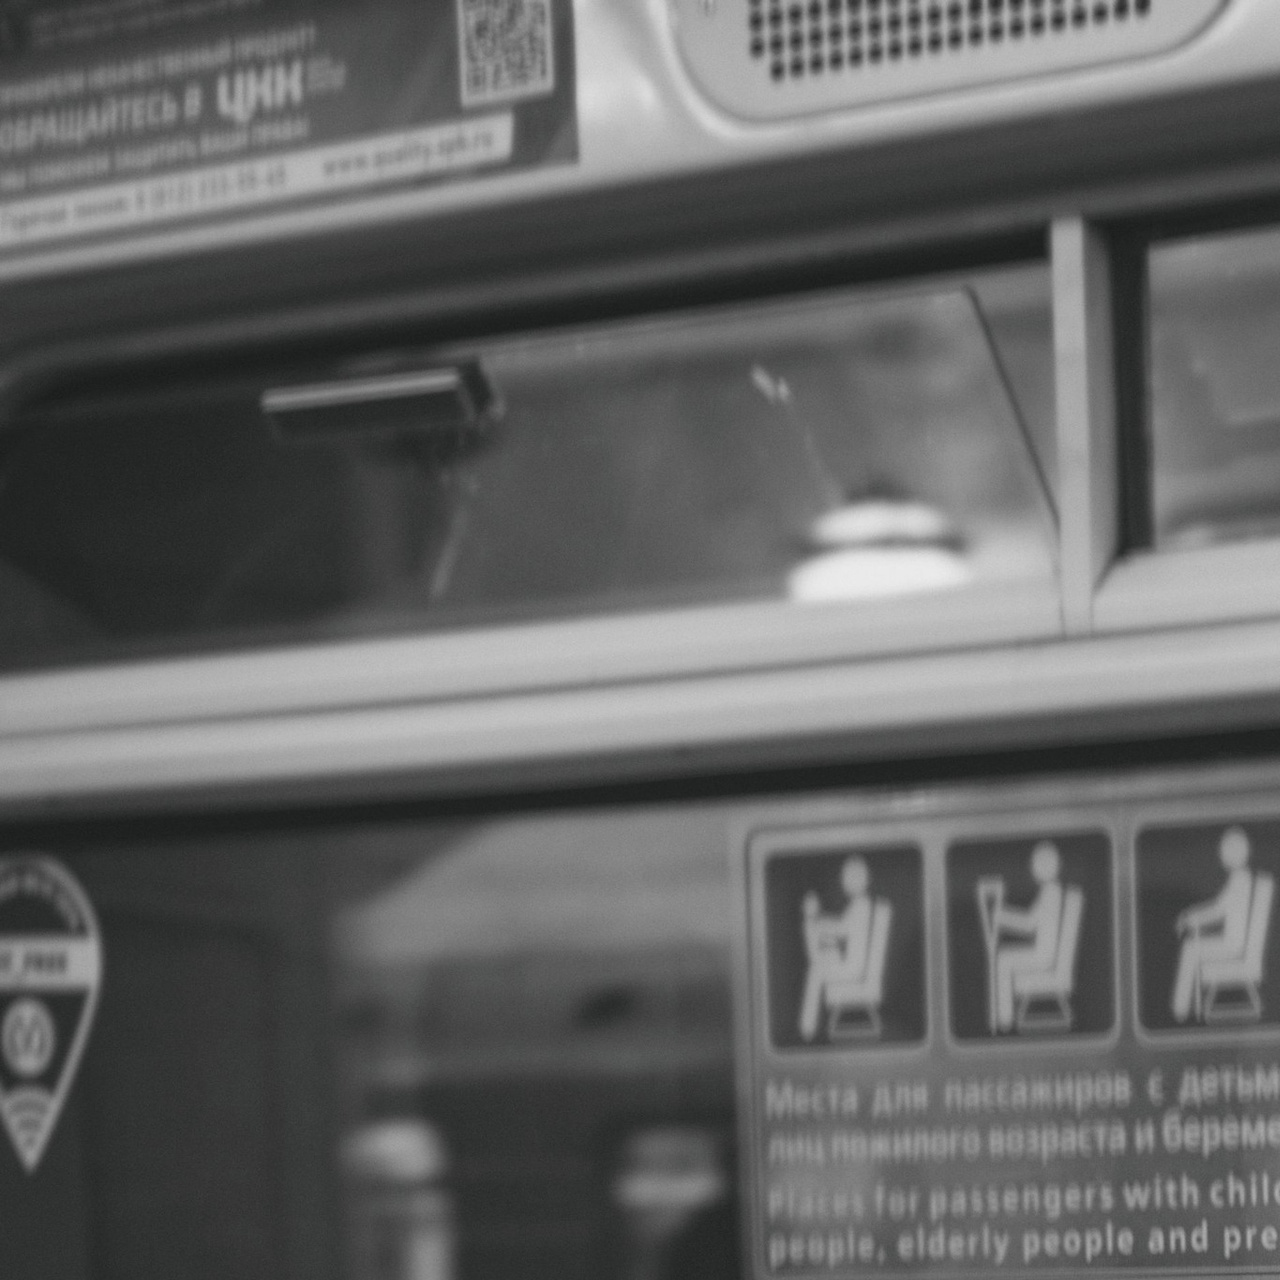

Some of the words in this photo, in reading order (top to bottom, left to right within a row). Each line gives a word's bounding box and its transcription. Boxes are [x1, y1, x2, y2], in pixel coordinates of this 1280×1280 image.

[765, 1079, 857, 1119] Места
[871, 1081, 928, 1120] для
[945, 1069, 1131, 1117] пассажиров
[1148, 1067, 1164, 1105] с
[831, 1124, 981, 1162] пожилого
[988, 1118, 1126, 1166] возраста
[1133, 1118, 1155, 1156] и
[875, 1177, 917, 1219] for
[929, 1183, 1114, 1222] passengers
[1123, 1171, 1200, 1210] with
[769, 1224, 886, 1271] people,
[897, 1221, 1009, 1266] elderly
[1023, 1218, 1133, 1264] people
[1148, 1218, 1208, 1254] and
